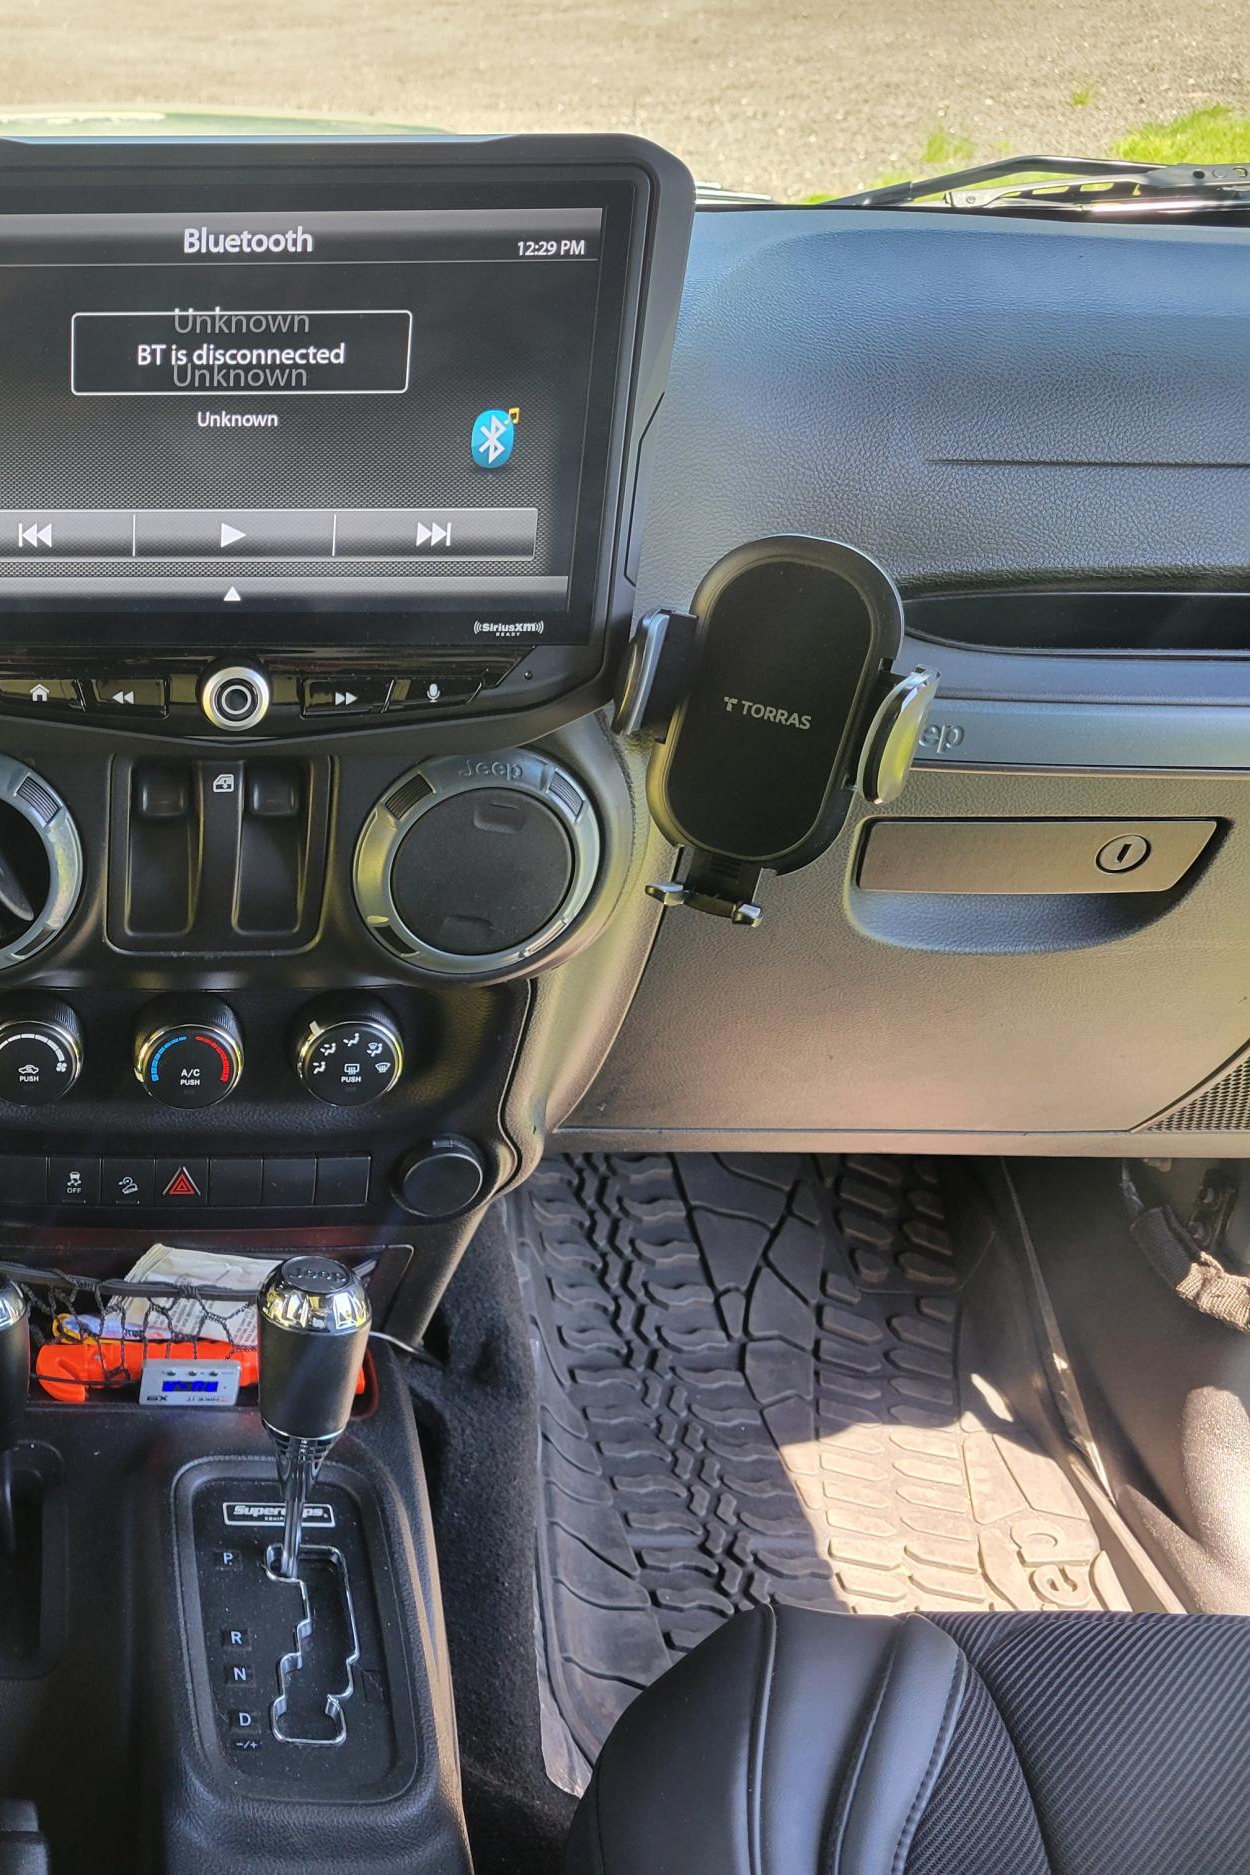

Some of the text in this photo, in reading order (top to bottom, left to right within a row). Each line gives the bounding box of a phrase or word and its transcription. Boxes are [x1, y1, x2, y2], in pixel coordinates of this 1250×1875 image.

[183, 228, 314, 253] Bluetooth
[517, 240, 586, 256] 12:29 PM
[174, 307, 310, 334] Unknown
[137, 343, 346, 365] BT is disconnected
[173, 363, 308, 388] Unknown
[197, 411, 278, 428] Unknown
[741, 700, 812, 730] TORRAS
[919, 724, 965, 754] ep
[181, 1069, 200, 1078] A/C
[223, 1552, 233, 1565] P
[230, 1631, 242, 1645] R
[234, 1667, 246, 1681] N
[238, 1712, 251, 1727] D
